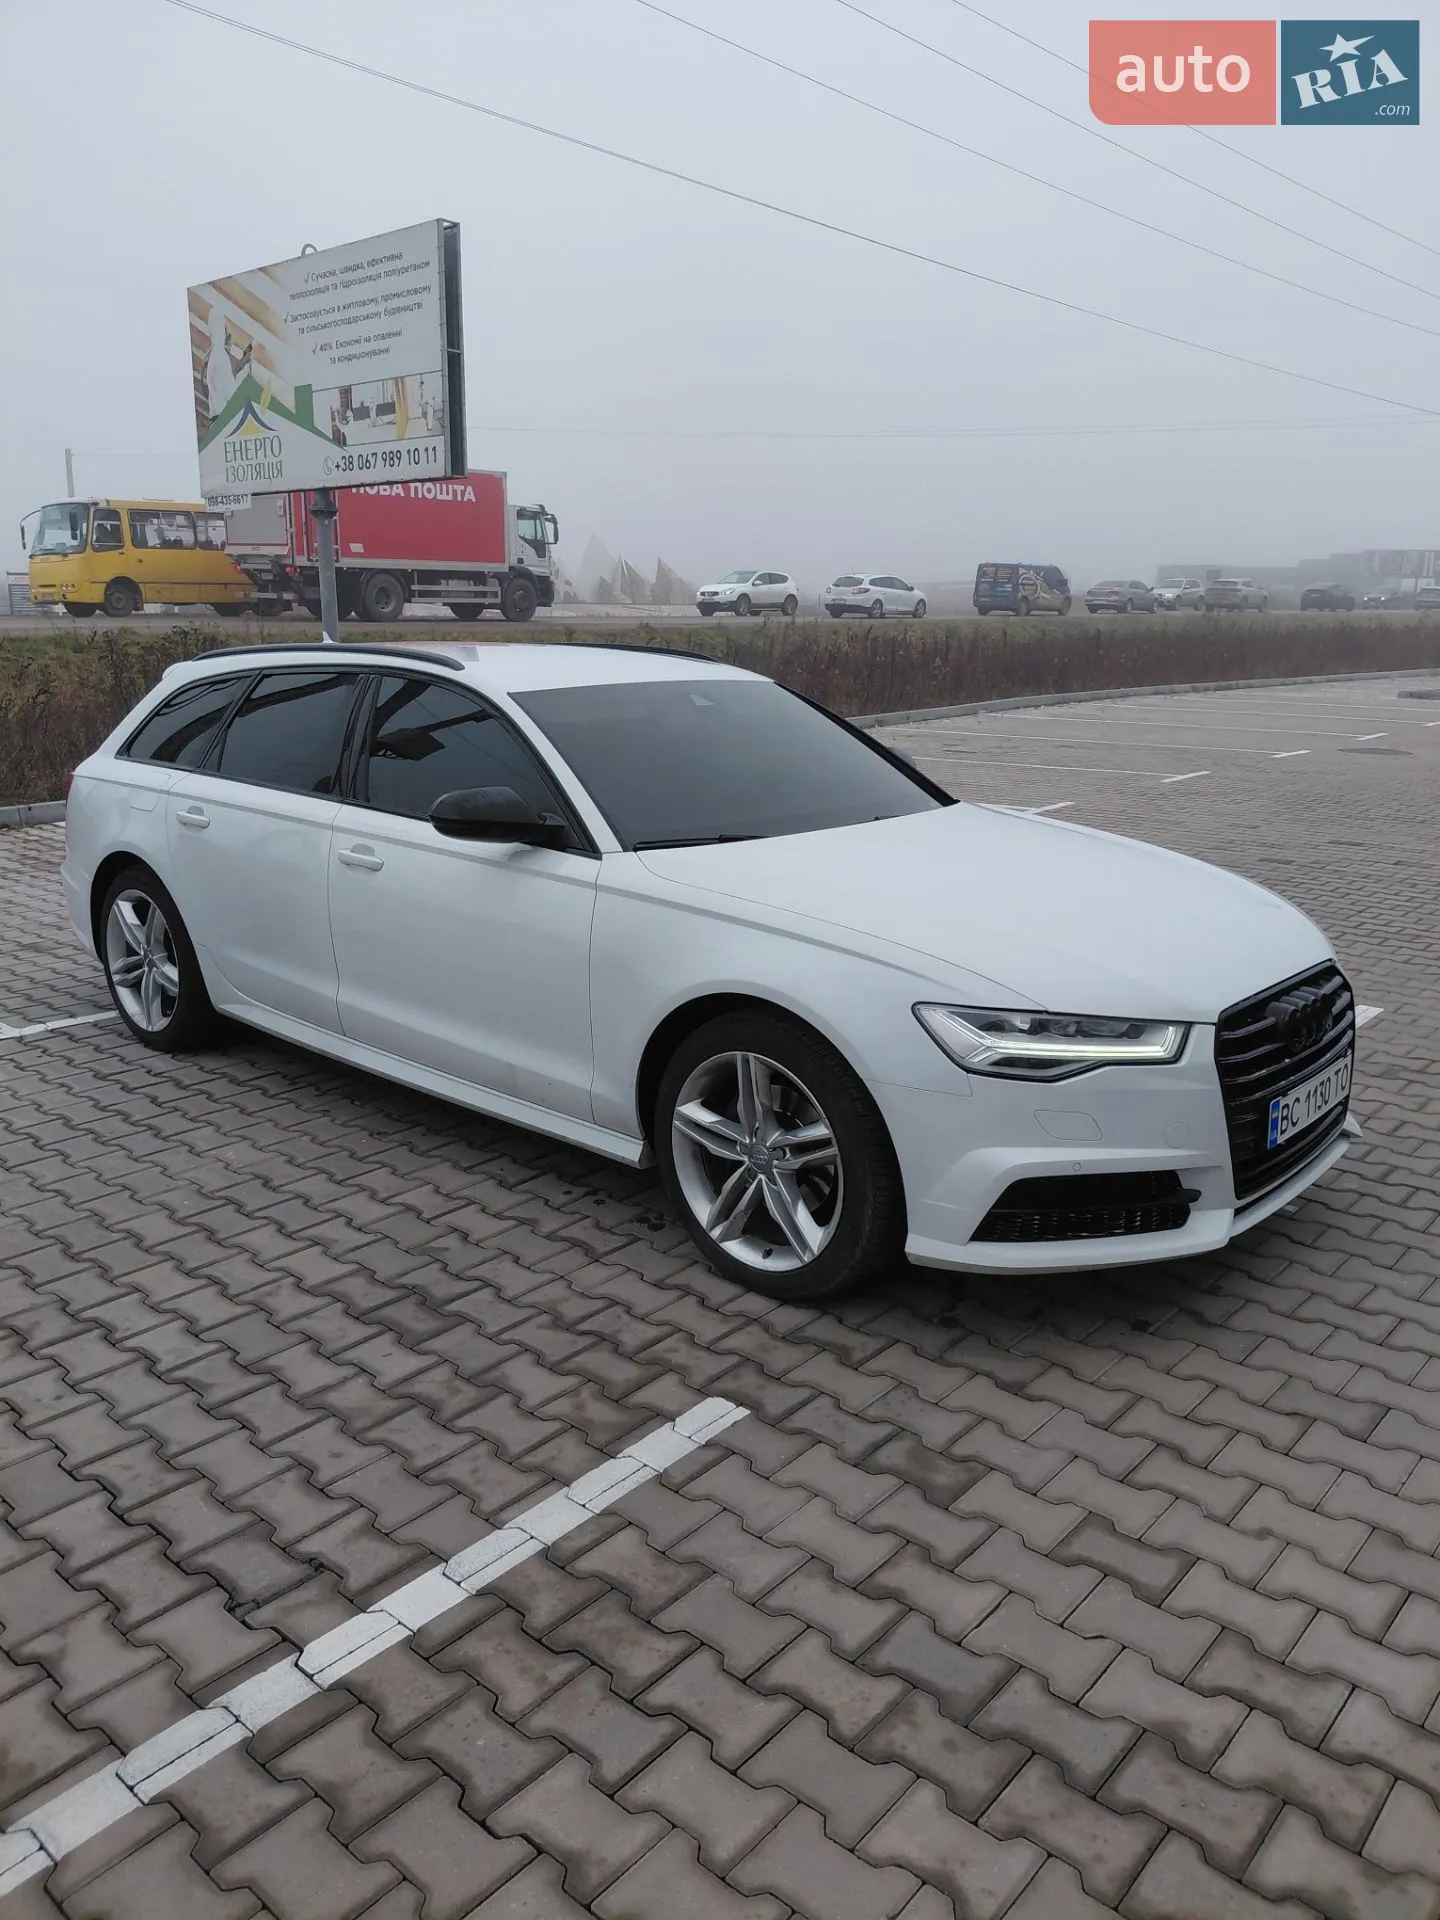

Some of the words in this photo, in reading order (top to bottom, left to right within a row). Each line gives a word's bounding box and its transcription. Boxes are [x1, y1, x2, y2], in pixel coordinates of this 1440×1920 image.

[339, 261, 366, 275] швидка,
[367, 252, 403, 268] ефективна
[331, 282, 338, 291] та
[381, 284, 432, 302] промисловому
[298, 326, 305, 335] та
[363, 335, 372, 344] на
[373, 328, 403, 342] опаленні
[330, 356, 337, 365] та
[224, 435, 282, 463] ЕНЕРГО
[335, 454, 354, 473] +38
[358, 451, 378, 471] 067
[381, 450, 401, 469] 989
[406, 447, 420, 466] 10
[424, 445, 438, 464] 11
[226, 460, 283, 485] ІЗОЛЯЦІЯ
[409, 482, 476, 502] ПОШТА
[1280, 1096, 1300, 1136] BC
[1305, 1076, 1331, 1119] 1130
[1335, 1063, 1349, 1097] TO
